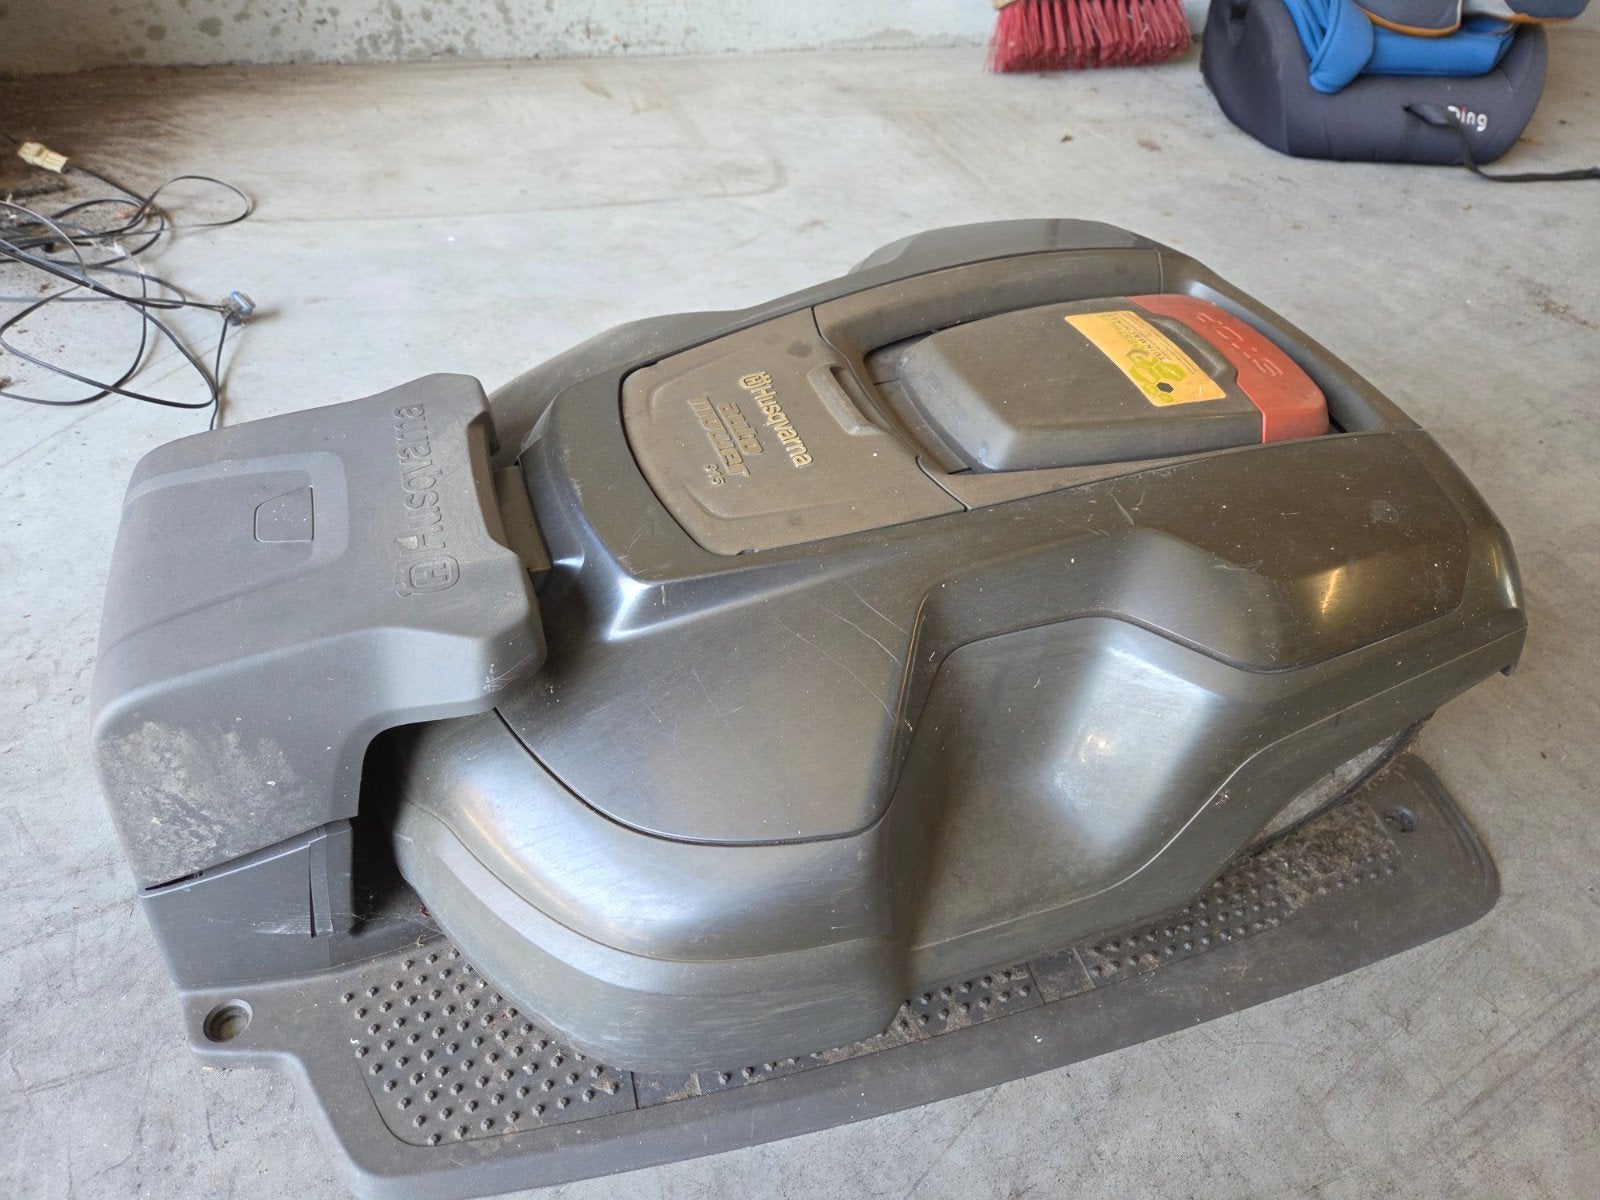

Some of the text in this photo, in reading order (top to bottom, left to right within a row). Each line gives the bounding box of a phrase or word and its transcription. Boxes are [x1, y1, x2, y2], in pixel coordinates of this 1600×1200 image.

[750, 379, 813, 468] Husqvarna
[393, 402, 447, 552] Husqvarna
[704, 463, 726, 485] 315
